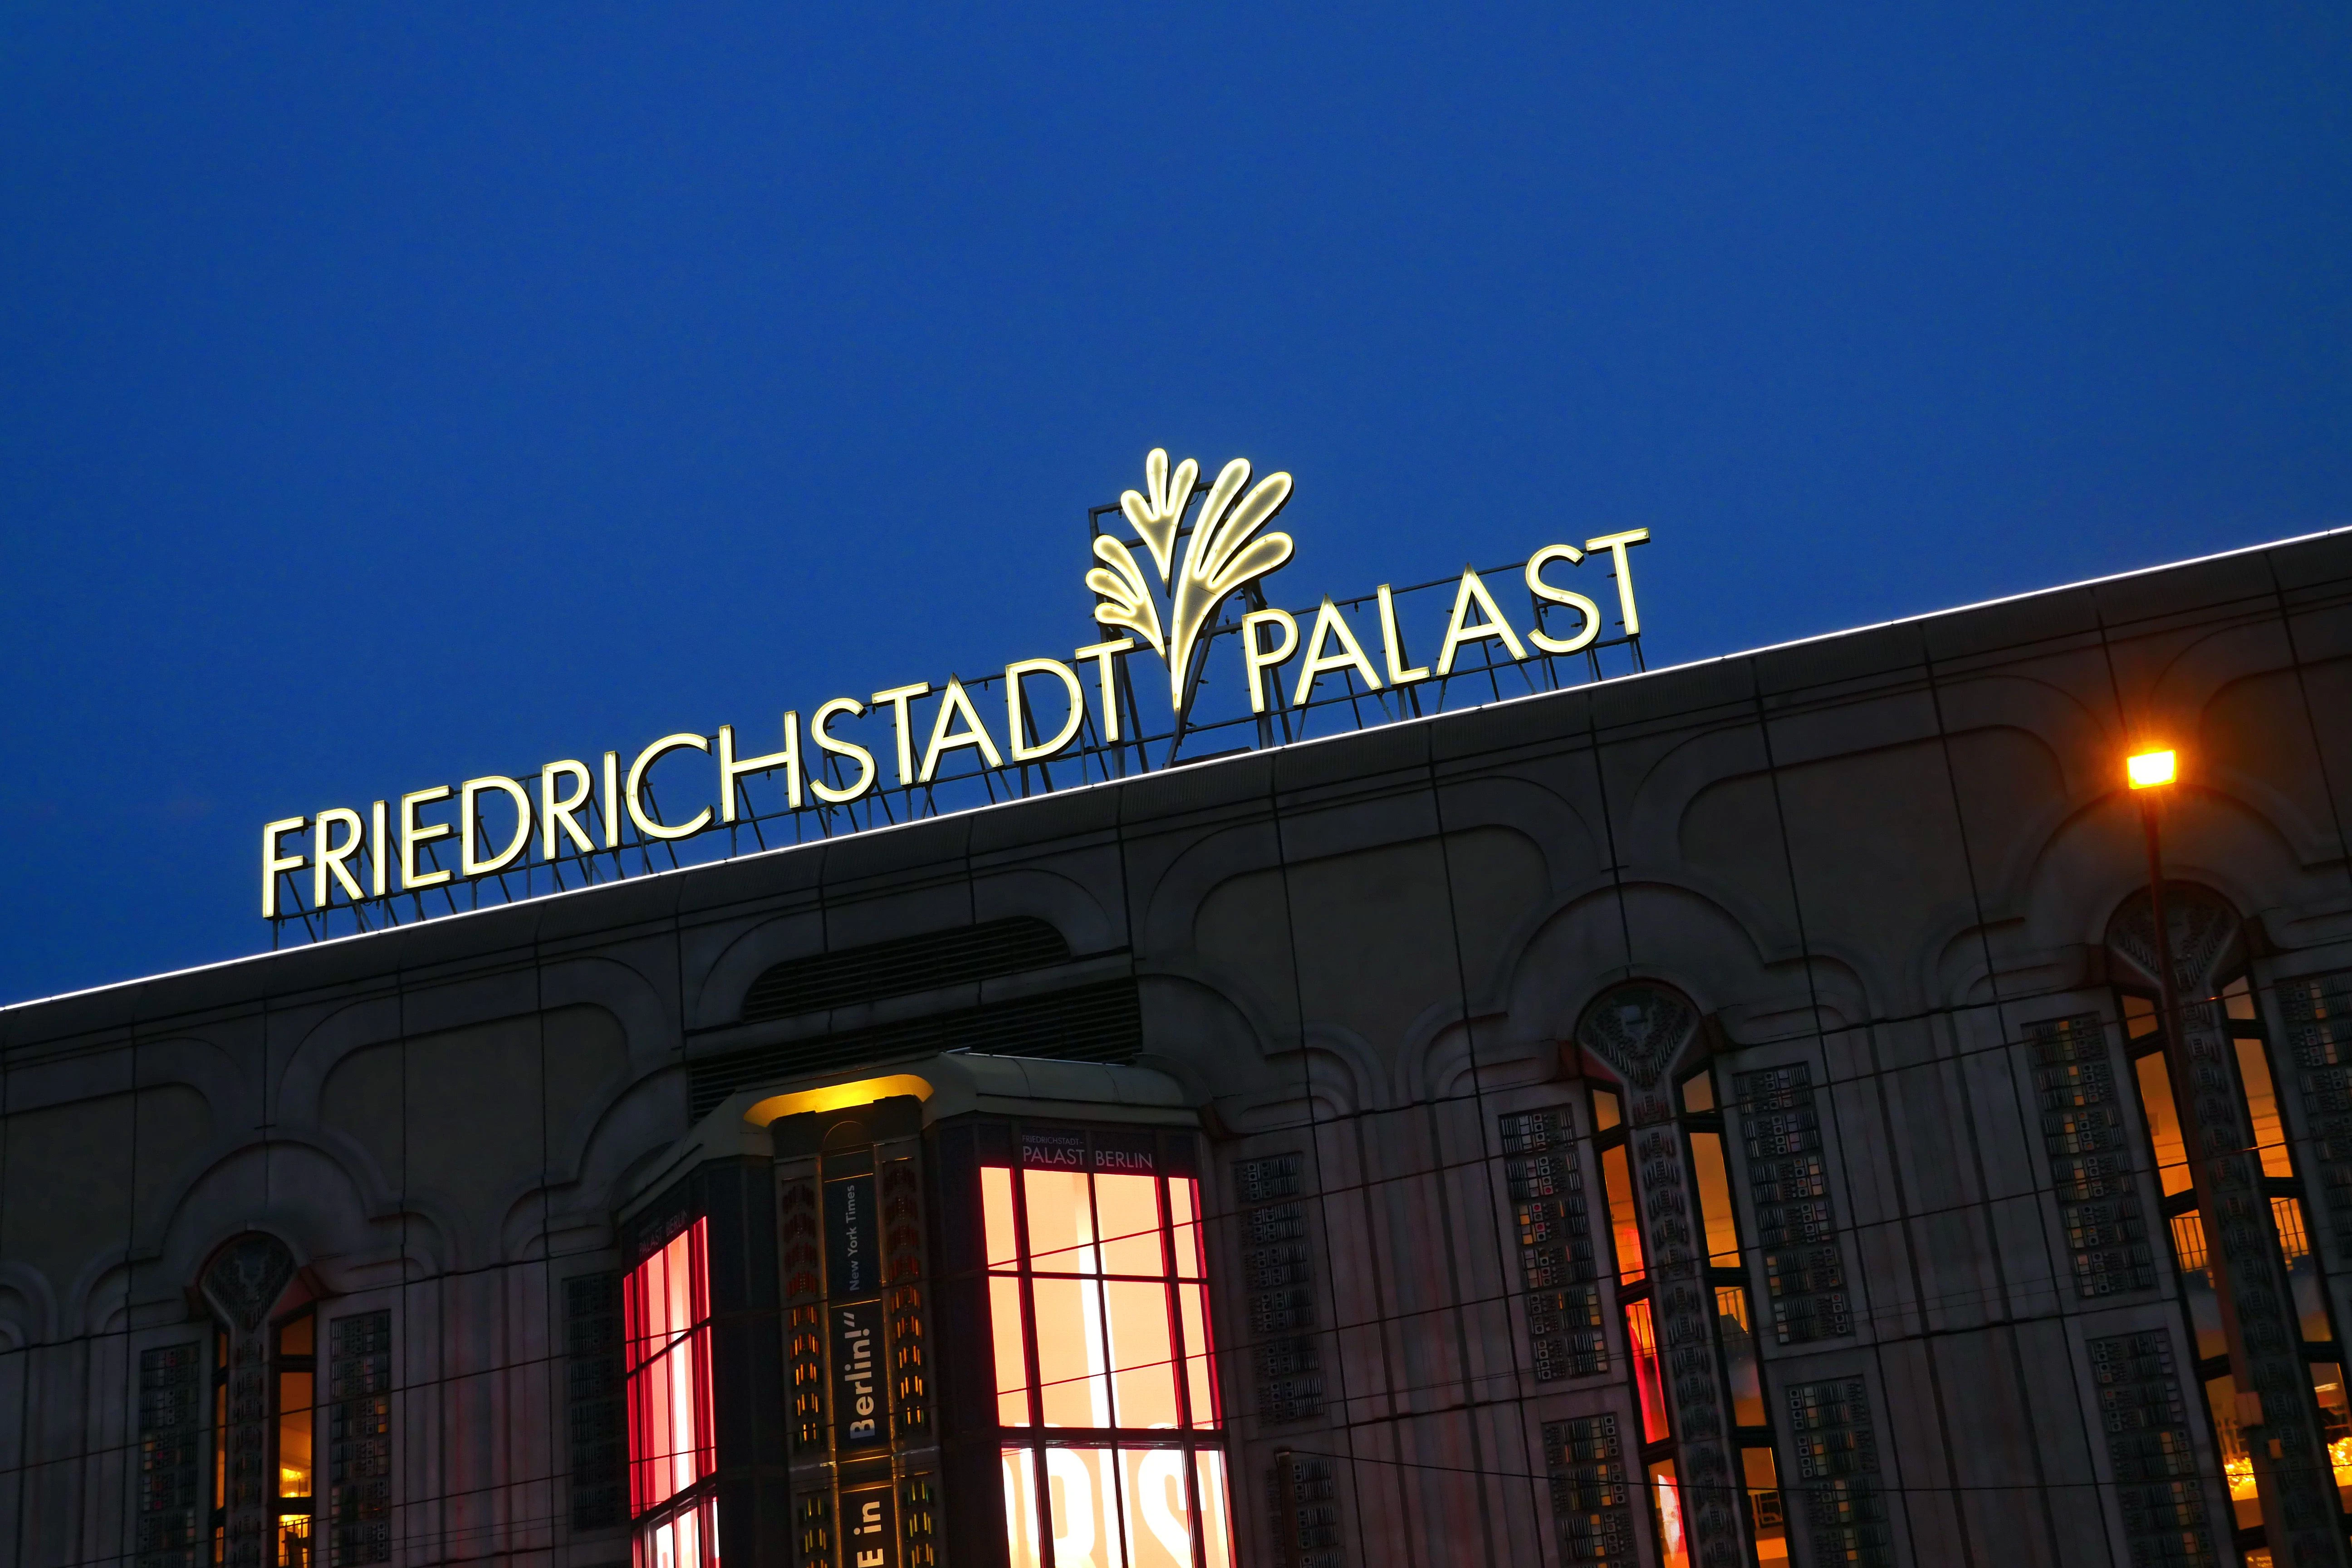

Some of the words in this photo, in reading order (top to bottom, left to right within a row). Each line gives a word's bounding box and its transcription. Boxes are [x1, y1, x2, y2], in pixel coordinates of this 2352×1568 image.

[263, 637, 1134, 918] FRIEDRICHSTADT
[1242, 527, 1650, 714] PALAST
[1022, 1146, 1085, 1166] PALAST
[1095, 1150, 1153, 1169] BERLIN
[846, 1185, 857, 1224] Times
[846, 1226, 858, 1257] York
[849, 1260, 860, 1291] New
[853, 1501, 882, 1535] in
